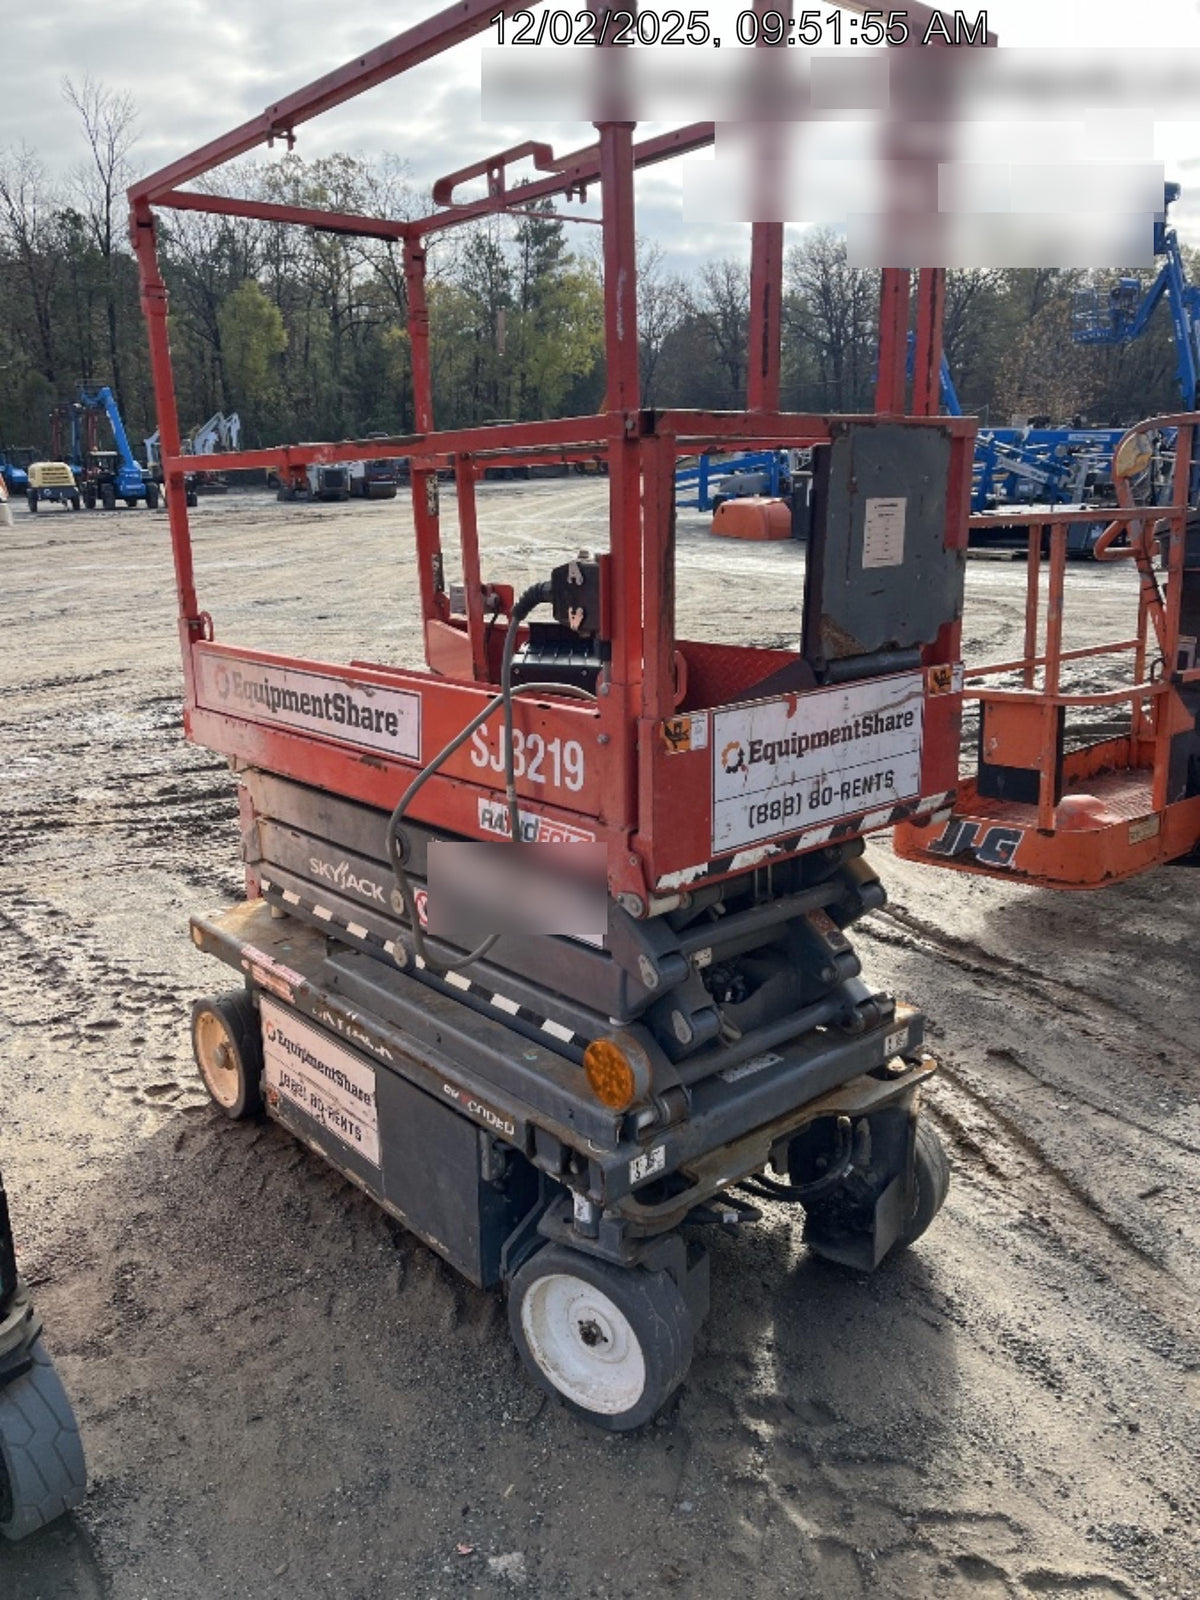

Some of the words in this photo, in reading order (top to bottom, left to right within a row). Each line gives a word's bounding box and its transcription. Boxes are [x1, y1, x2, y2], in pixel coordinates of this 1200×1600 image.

[232, 671, 399, 736] EquipmentShare
[470, 723, 584, 792] SJ3219
[748, 710, 914, 765] EquipmentShare
[927, 818, 1026, 869] JLG
[309, 857, 387, 904] SKYJACK
[277, 1028, 373, 1106] EquipmentShare
